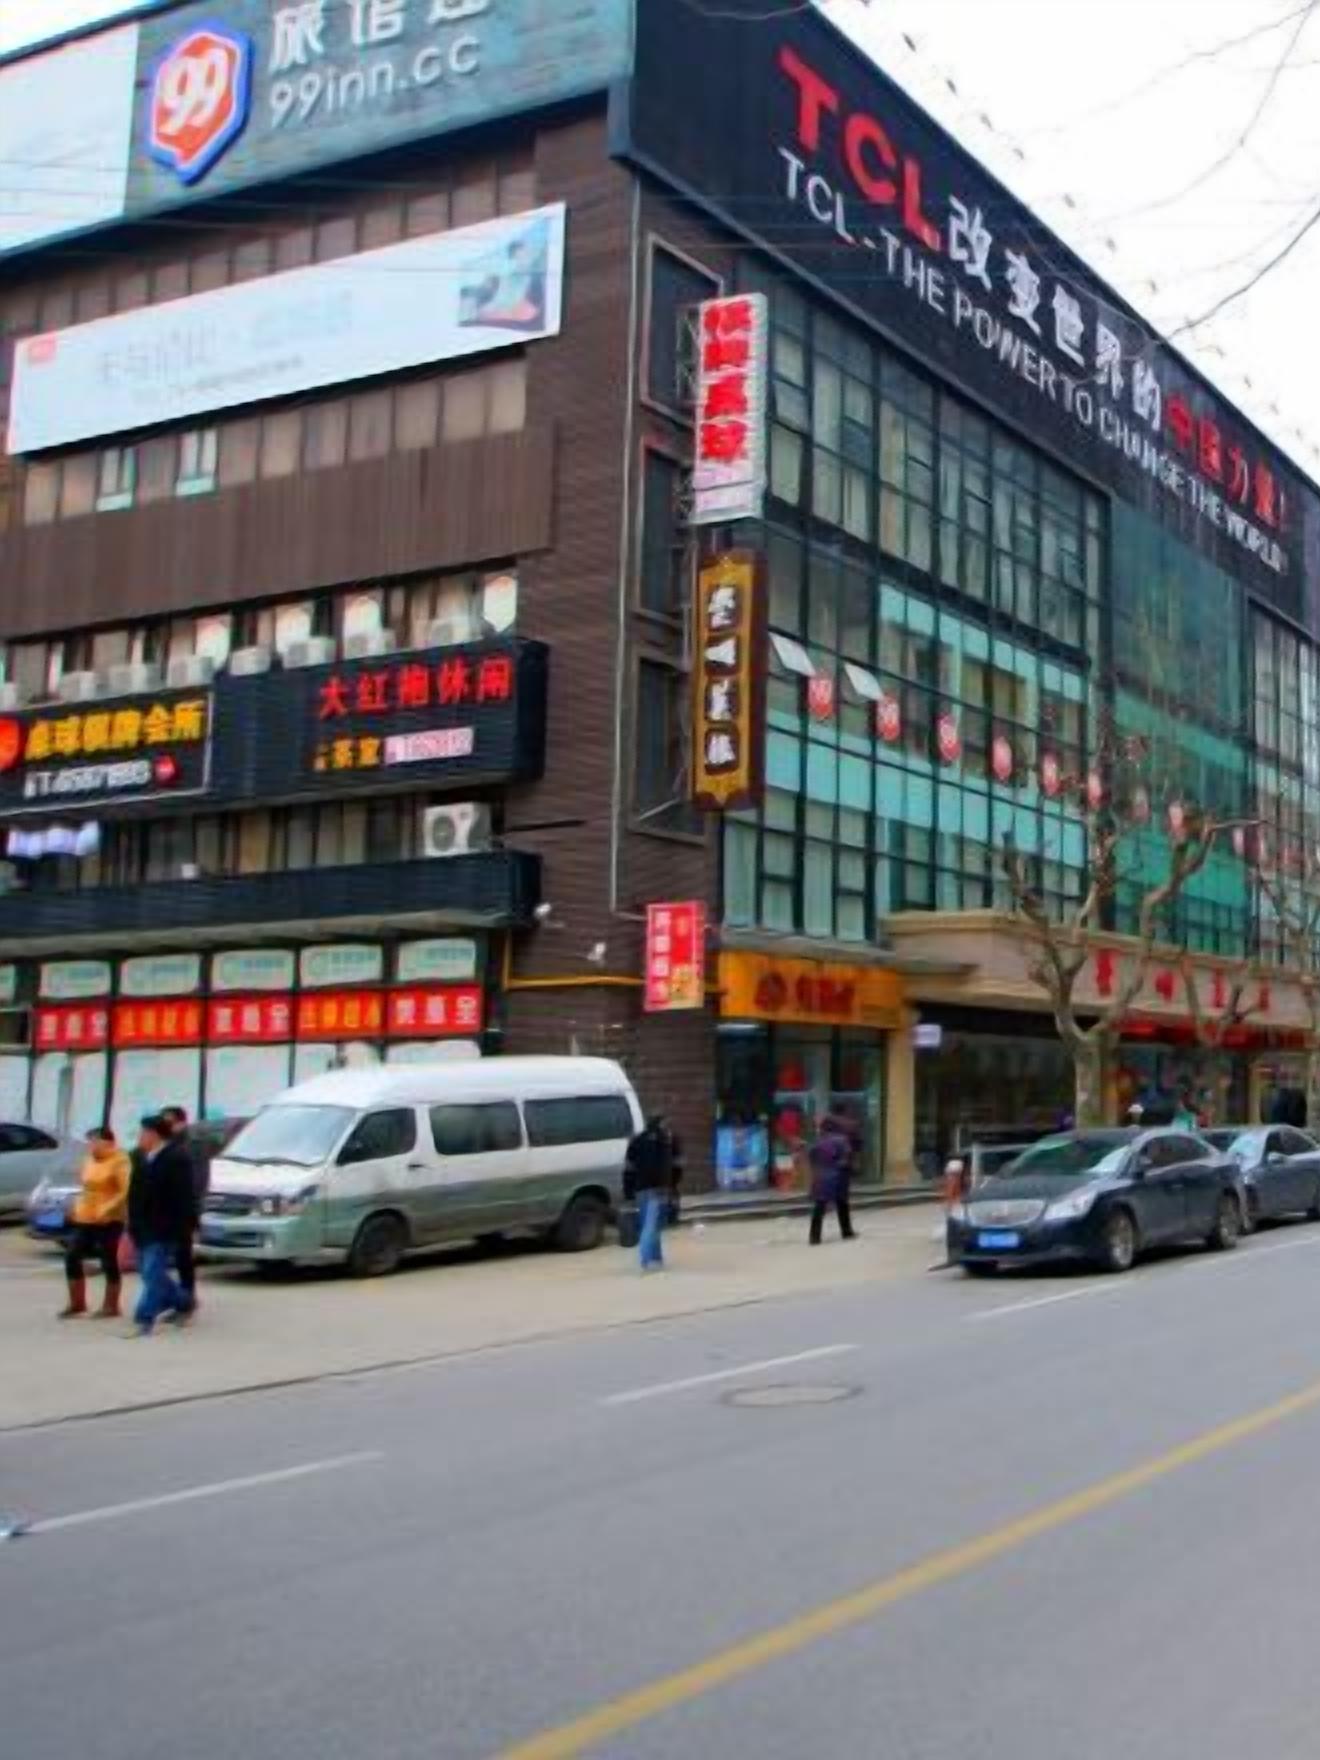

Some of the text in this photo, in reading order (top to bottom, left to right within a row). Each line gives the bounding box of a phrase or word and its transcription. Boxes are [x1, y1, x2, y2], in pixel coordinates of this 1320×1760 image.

[158, 48, 228, 136] 99
[269, 36, 481, 128] 99inn.cc
[778, 44, 941, 252] TCL
[953, 282, 1057, 400] POWER
[1058, 372, 1093, 426] TO
